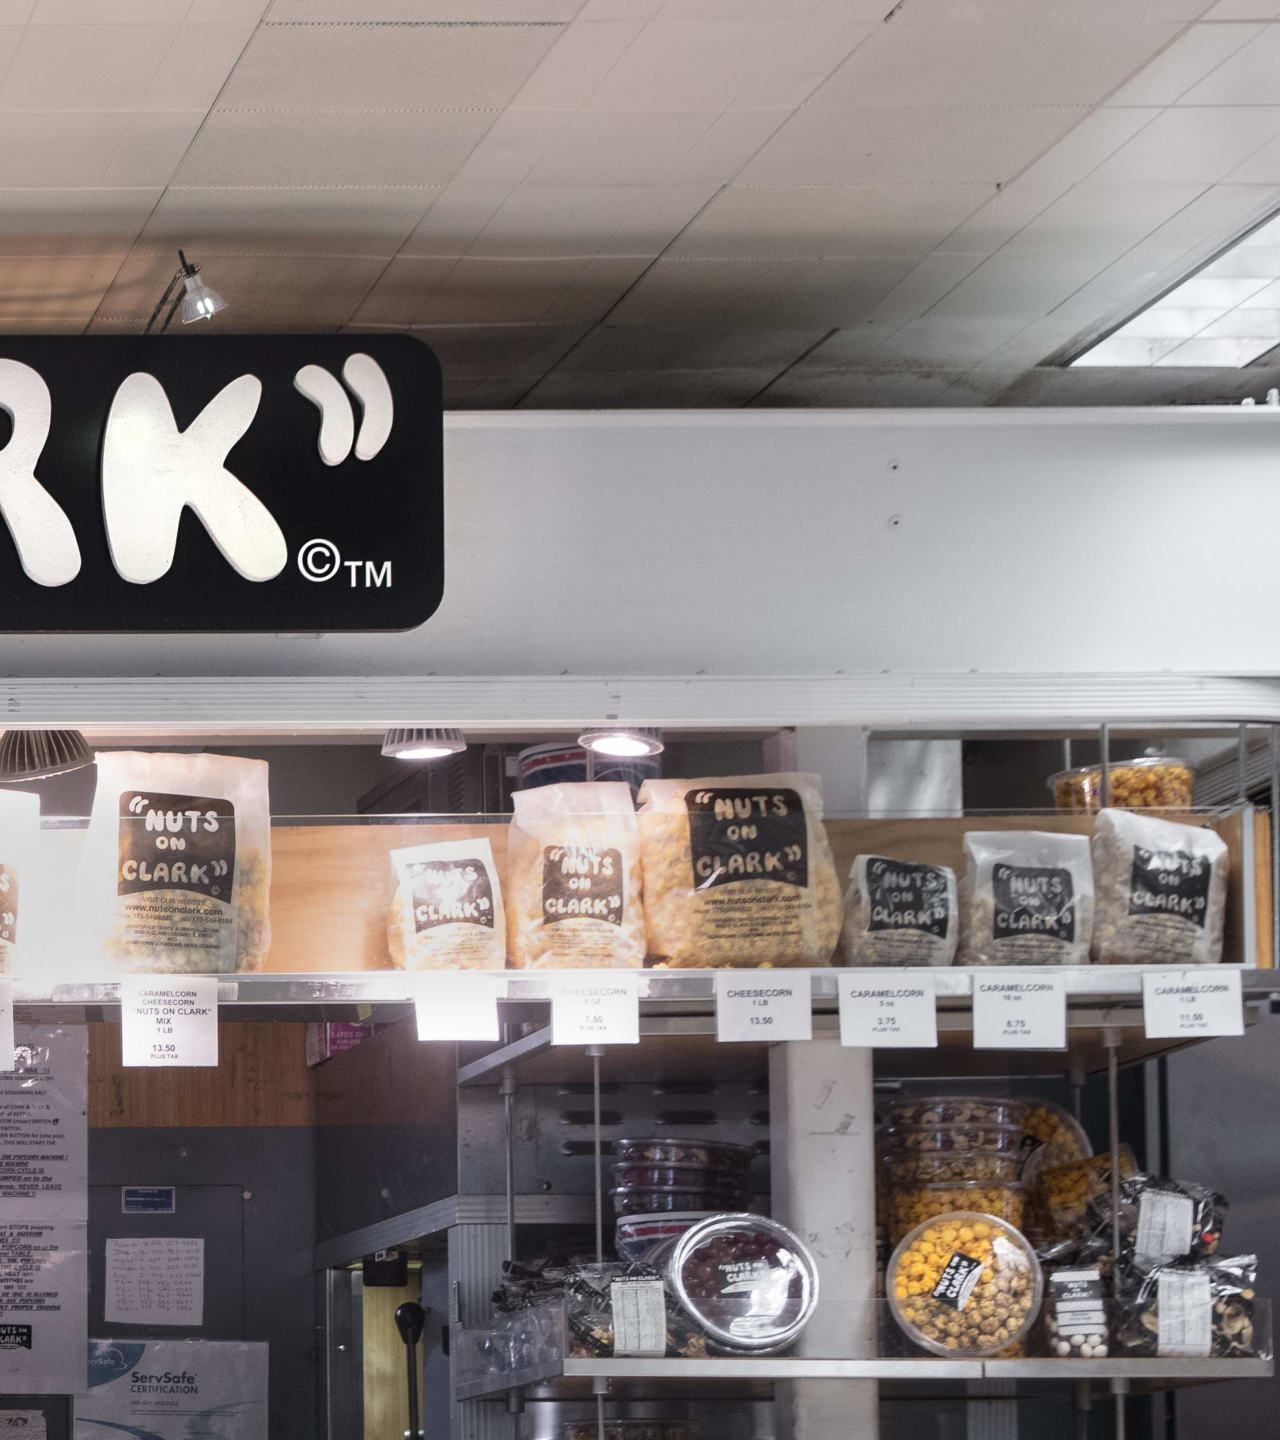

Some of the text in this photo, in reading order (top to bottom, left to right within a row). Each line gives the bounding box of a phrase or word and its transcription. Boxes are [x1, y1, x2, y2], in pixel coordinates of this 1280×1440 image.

[695, 791, 788, 820] "NUTS
[129, 795, 219, 833] "NUTS
[727, 824, 757, 841] ON
[156, 836, 186, 850] ON
[696, 844, 801, 876] CLARK"
[122, 859, 227, 884] CLARK"
[727, 988, 792, 998] CHEESECORN
[851, 989, 924, 998] CARAMELCORN
[750, 1016, 773, 1024] 13.50
[131, 1371, 195, 1384] ServSafe
[130, 1385, 198, 1395] CERTIFICATION
